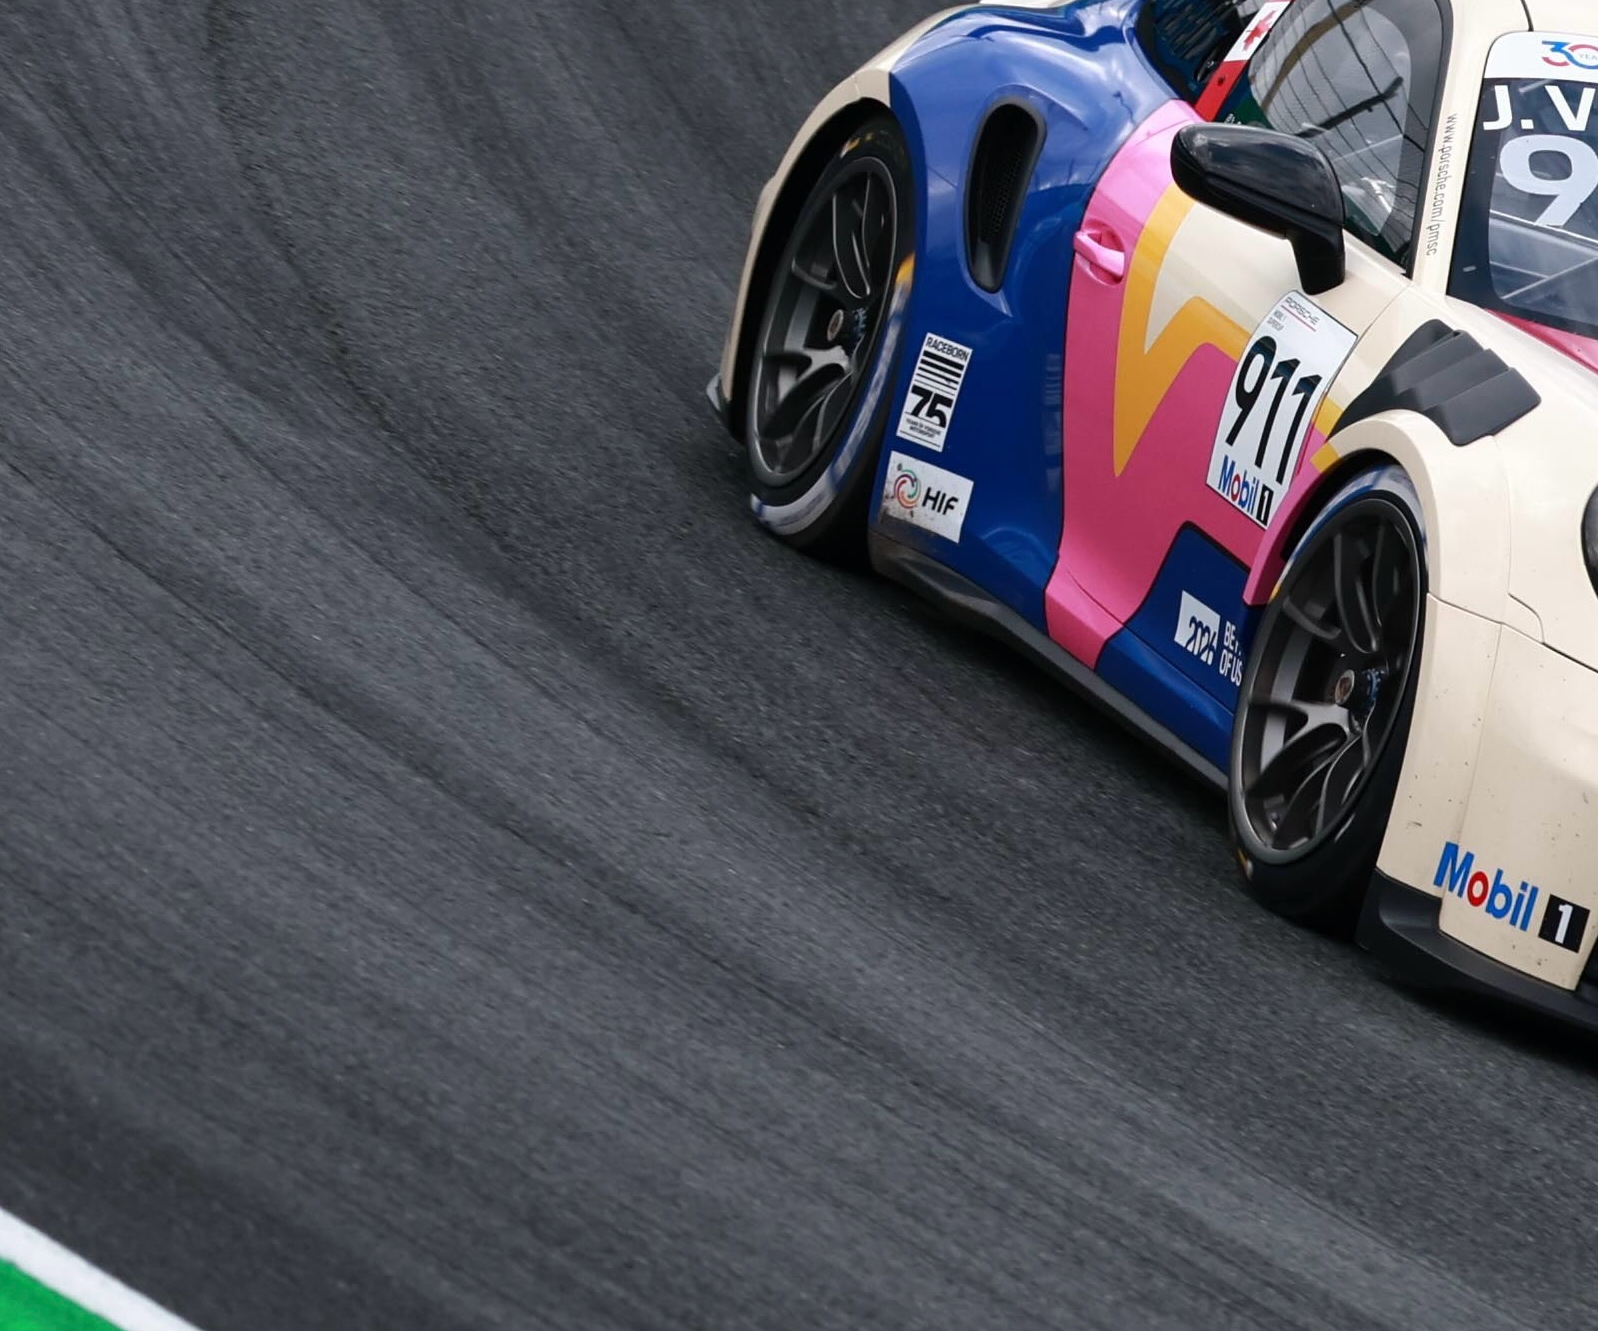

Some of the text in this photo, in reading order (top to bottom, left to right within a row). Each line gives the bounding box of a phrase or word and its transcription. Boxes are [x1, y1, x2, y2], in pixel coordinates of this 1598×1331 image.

[1483, 84, 1534, 131] J.
[1285, 296, 1320, 326] PORSCHE
[926, 337, 970, 362] RACEBORN
[910, 384, 953, 429] 75
[1225, 335, 1323, 485] 911
[922, 486, 959, 516] HIF
[1218, 454, 1260, 515] Mobil
[1223, 621, 1236, 649] BE
[1220, 649, 1243, 686] OF US
[1433, 841, 1539, 932] Mobil
